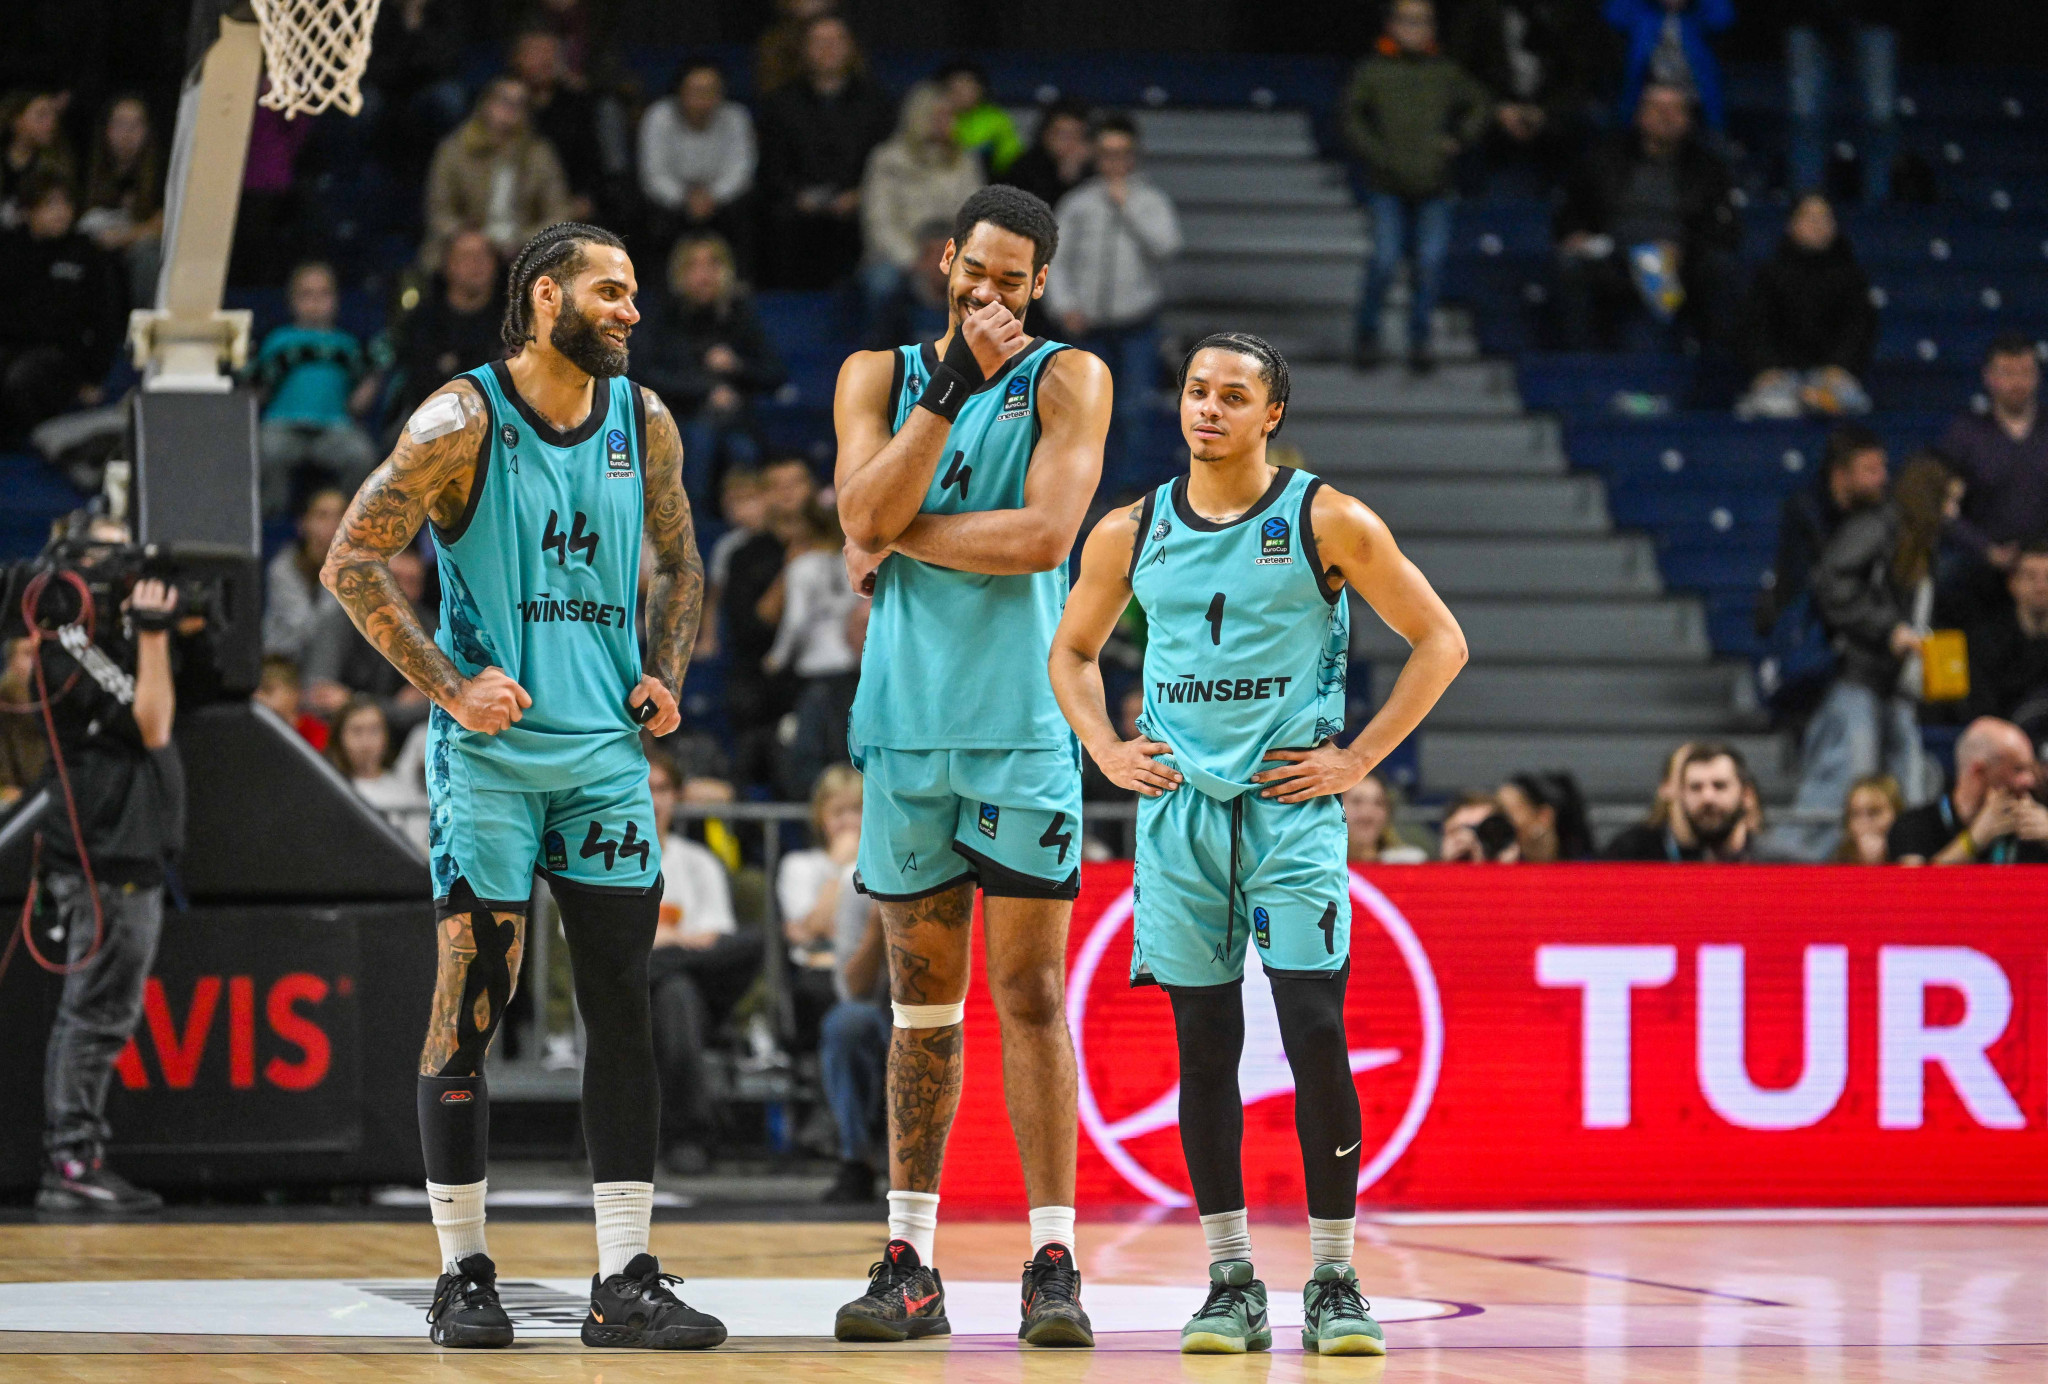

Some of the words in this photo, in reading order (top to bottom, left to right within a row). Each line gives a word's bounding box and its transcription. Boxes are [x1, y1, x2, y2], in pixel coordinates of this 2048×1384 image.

[940, 450, 972, 501] 4
[541, 509, 599, 566] 44
[1255, 556, 1292, 565] oneteam
[517, 593, 626, 629] WINSBET
[1205, 592, 1226, 646] 1
[1156, 673, 1292, 703] TWINSBET
[579, 820, 650, 872] 44
[1039, 811, 1072, 865] 4
[1318, 901, 1337, 955] 1
